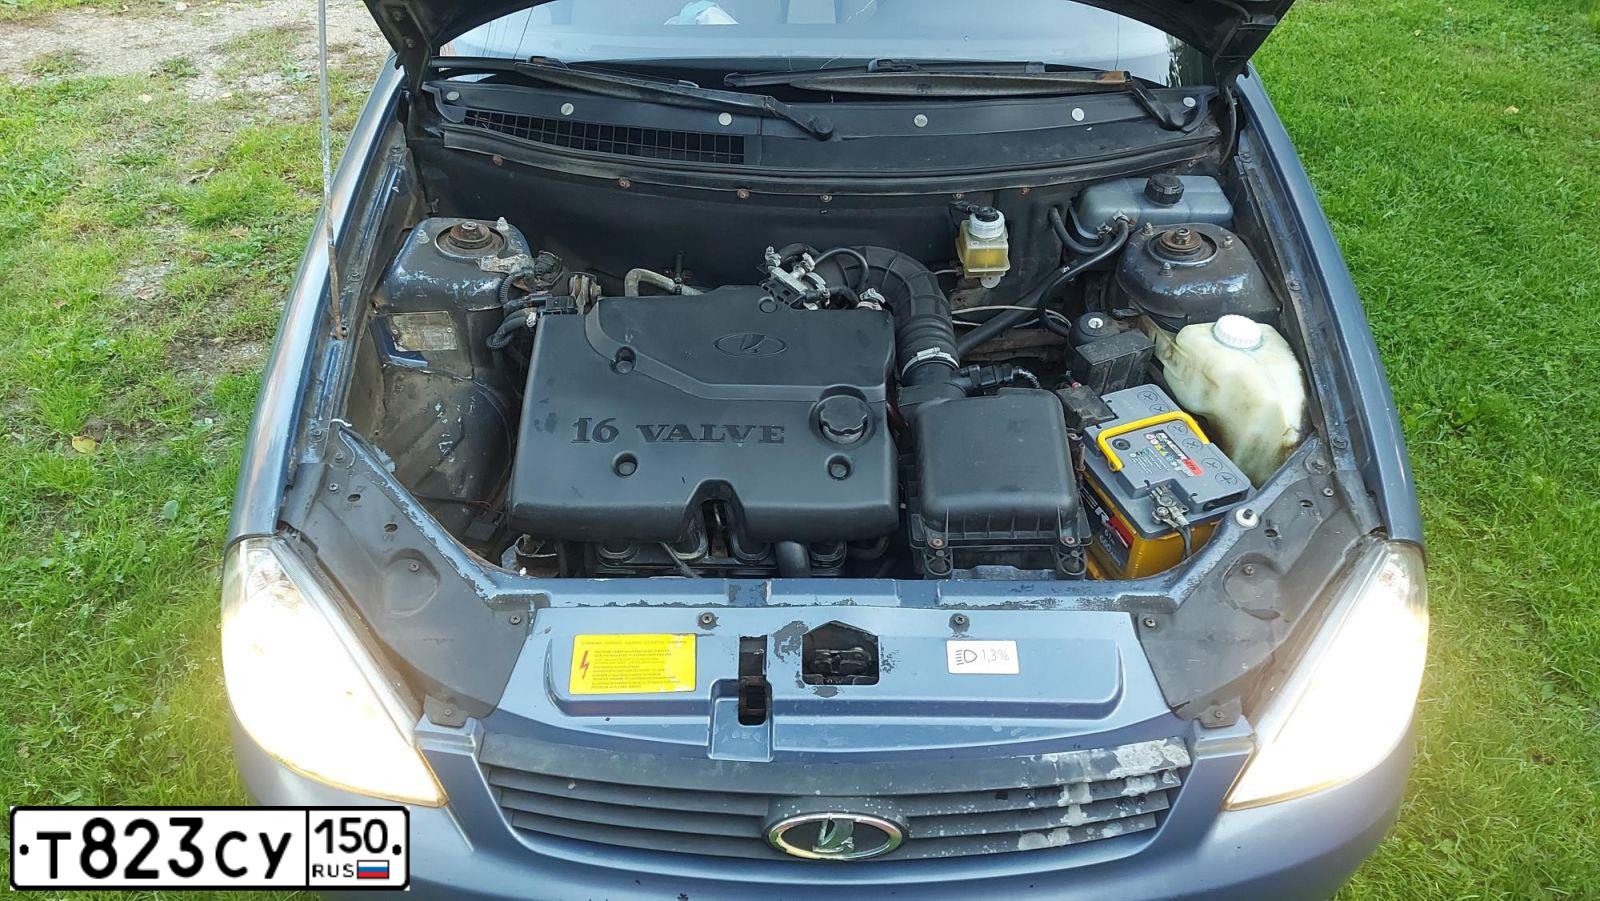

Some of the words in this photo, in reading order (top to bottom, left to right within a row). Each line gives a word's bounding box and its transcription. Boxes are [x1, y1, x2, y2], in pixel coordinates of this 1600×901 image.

[571, 416, 619, 444] 16
[635, 423, 785, 445] VALVE
[982, 648, 1010, 664] 1,3%
